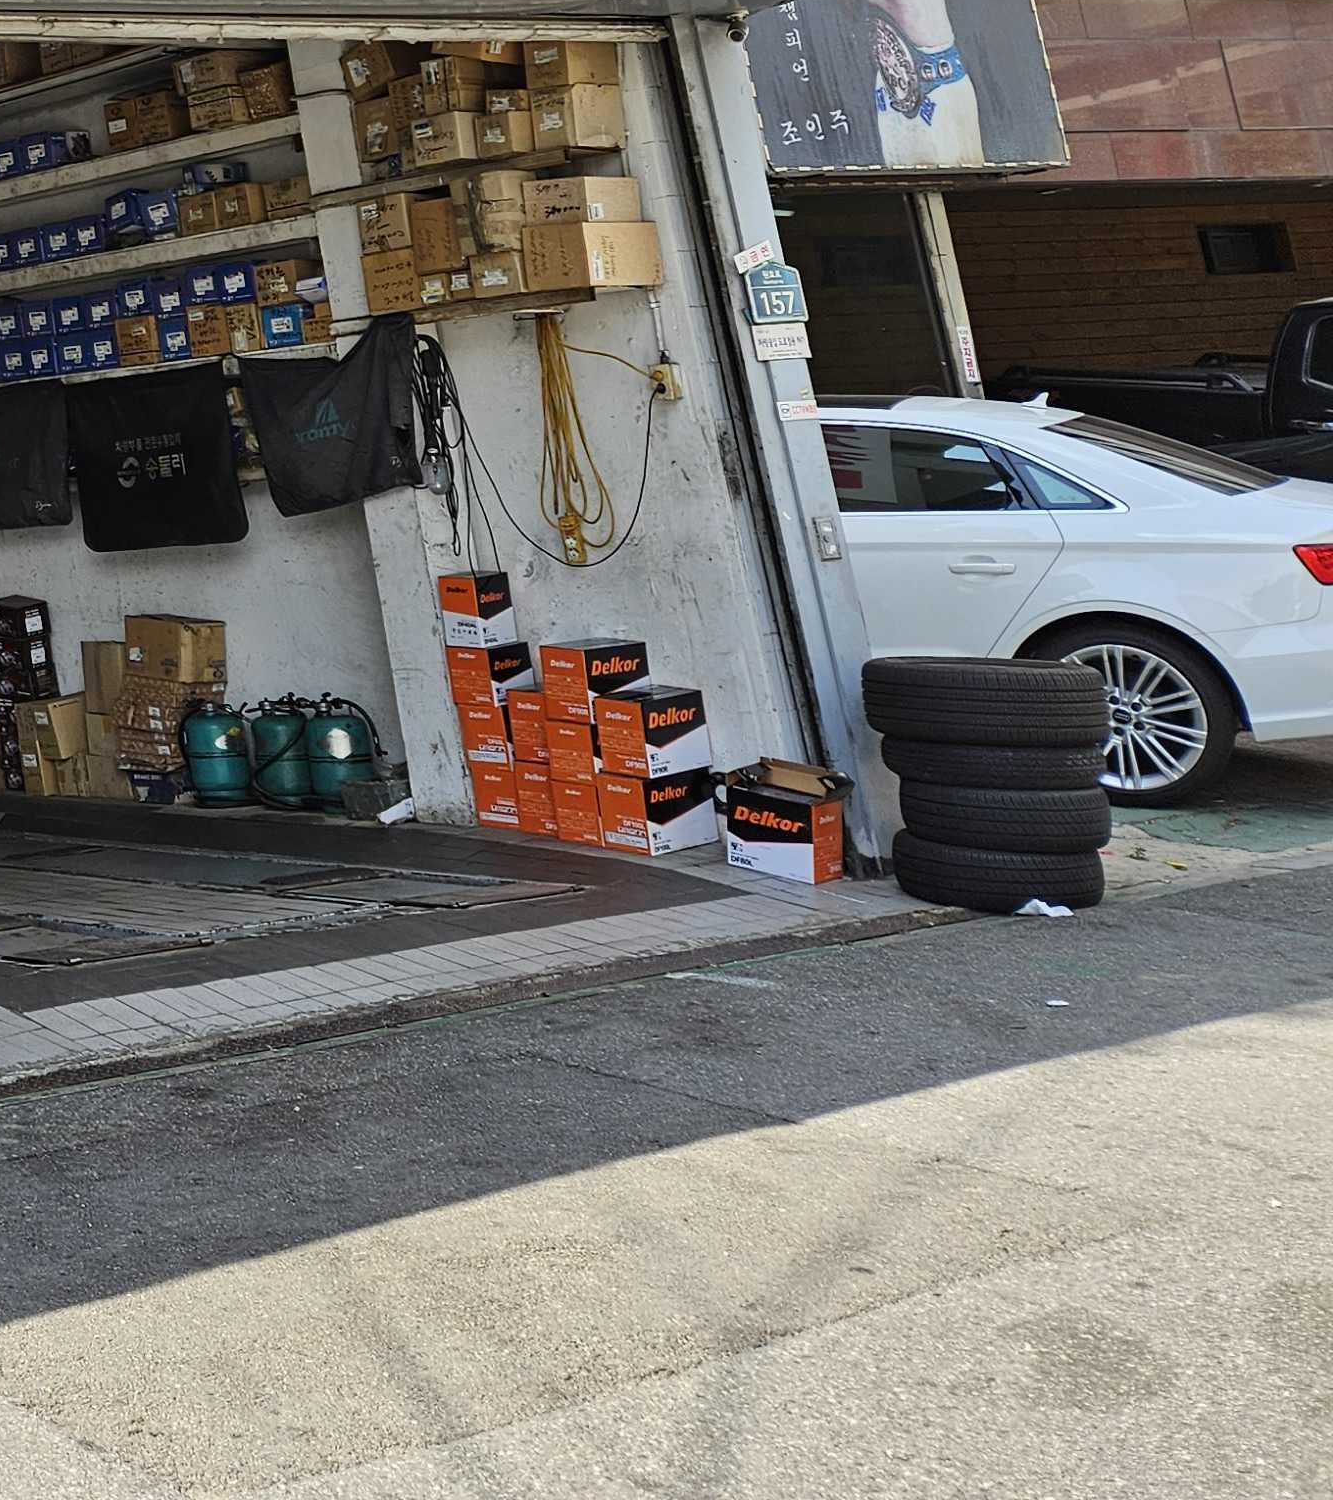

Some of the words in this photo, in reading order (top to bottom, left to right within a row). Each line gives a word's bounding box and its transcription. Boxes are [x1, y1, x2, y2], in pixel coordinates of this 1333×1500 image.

[780, 109, 850, 146] 조인주
[760, 290, 795, 317] 157
[590, 656, 641, 677] Delkor
[648, 706, 697, 730] Delkor
[650, 784, 688, 804] Delkor
[734, 805, 807, 834] Delkor
